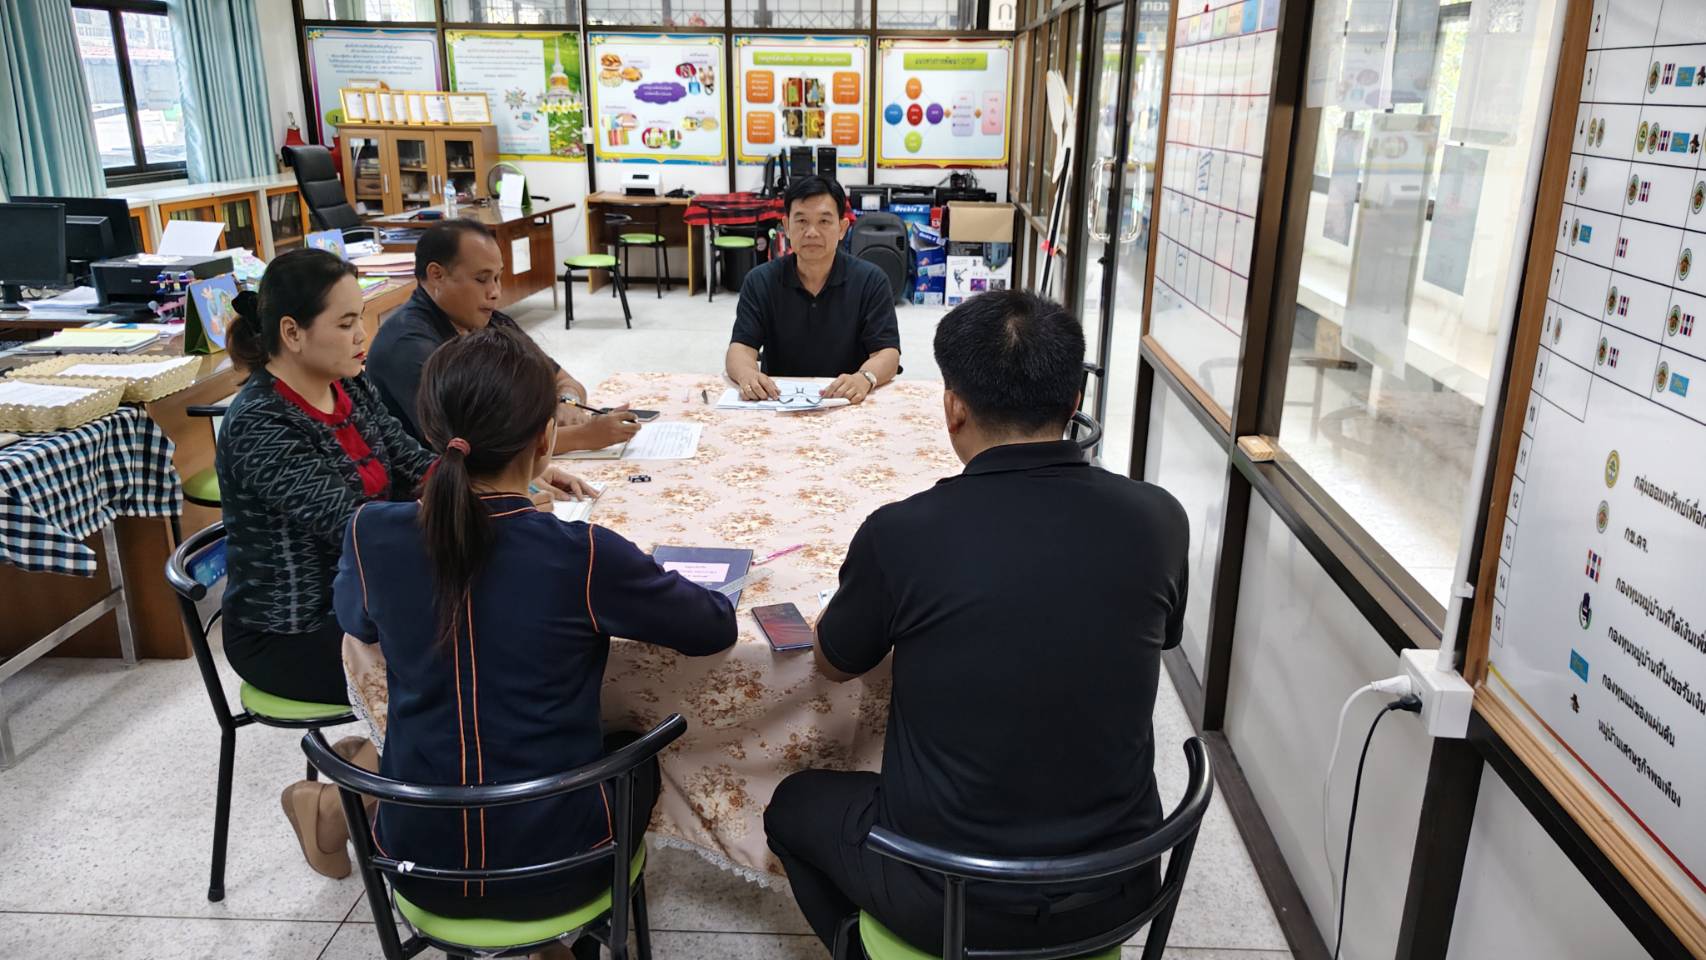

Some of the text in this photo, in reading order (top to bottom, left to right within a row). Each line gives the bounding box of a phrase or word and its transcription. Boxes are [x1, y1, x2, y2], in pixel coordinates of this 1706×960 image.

[1594, 14, 1601, 33] 2
[1587, 67, 1593, 86] 3
[1579, 119, 1585, 135] 4
[1570, 170, 1577, 188] 5
[1554, 268, 1560, 284] 7
[1529, 406, 1536, 422] 10
[1520, 449, 1527, 466] 11
[1512, 491, 1519, 507] 12
[1505, 534, 1512, 550] 13
[1499, 574, 1506, 590] 14
[1495, 614, 1502, 631] 15
[1602, 673, 1676, 748] กองทุนแม่ของแผ่นดิน
[1598, 719, 1681, 808] หมู่บ้านเศรษฐกิจพอเพียง
